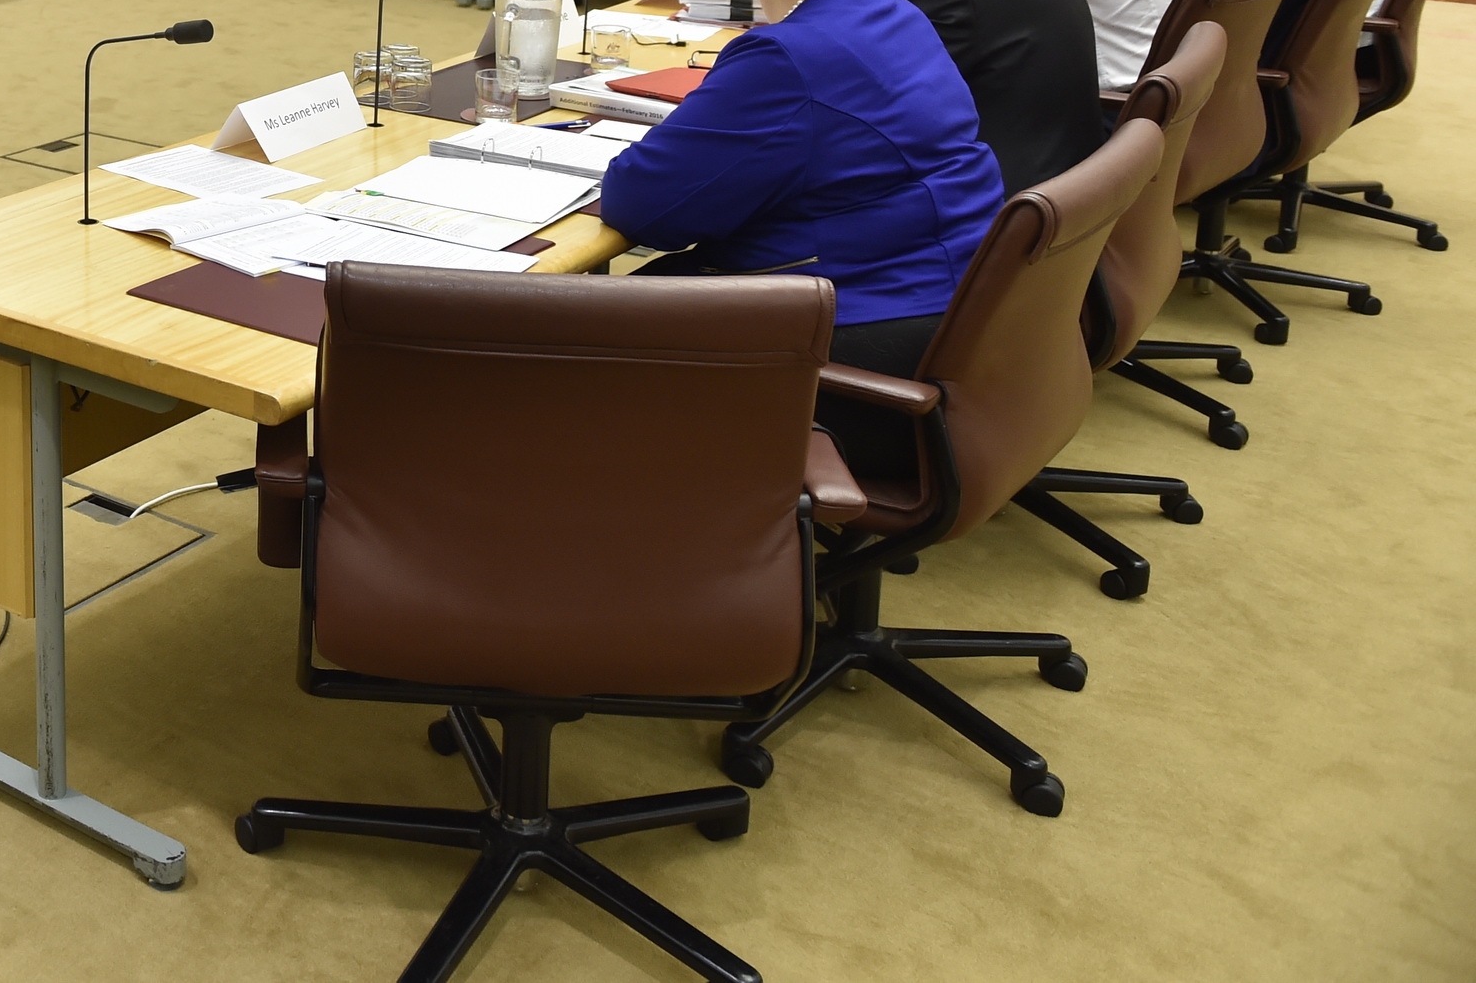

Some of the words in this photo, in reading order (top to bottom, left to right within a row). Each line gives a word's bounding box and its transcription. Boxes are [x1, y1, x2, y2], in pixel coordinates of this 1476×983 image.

[264, 118, 280, 131] Ms
[278, 107, 312, 126] Leanne
[310, 97, 340, 114] Harvey
[559, 97, 589, 108] Additional
[648, 110, 664, 120] 2016
